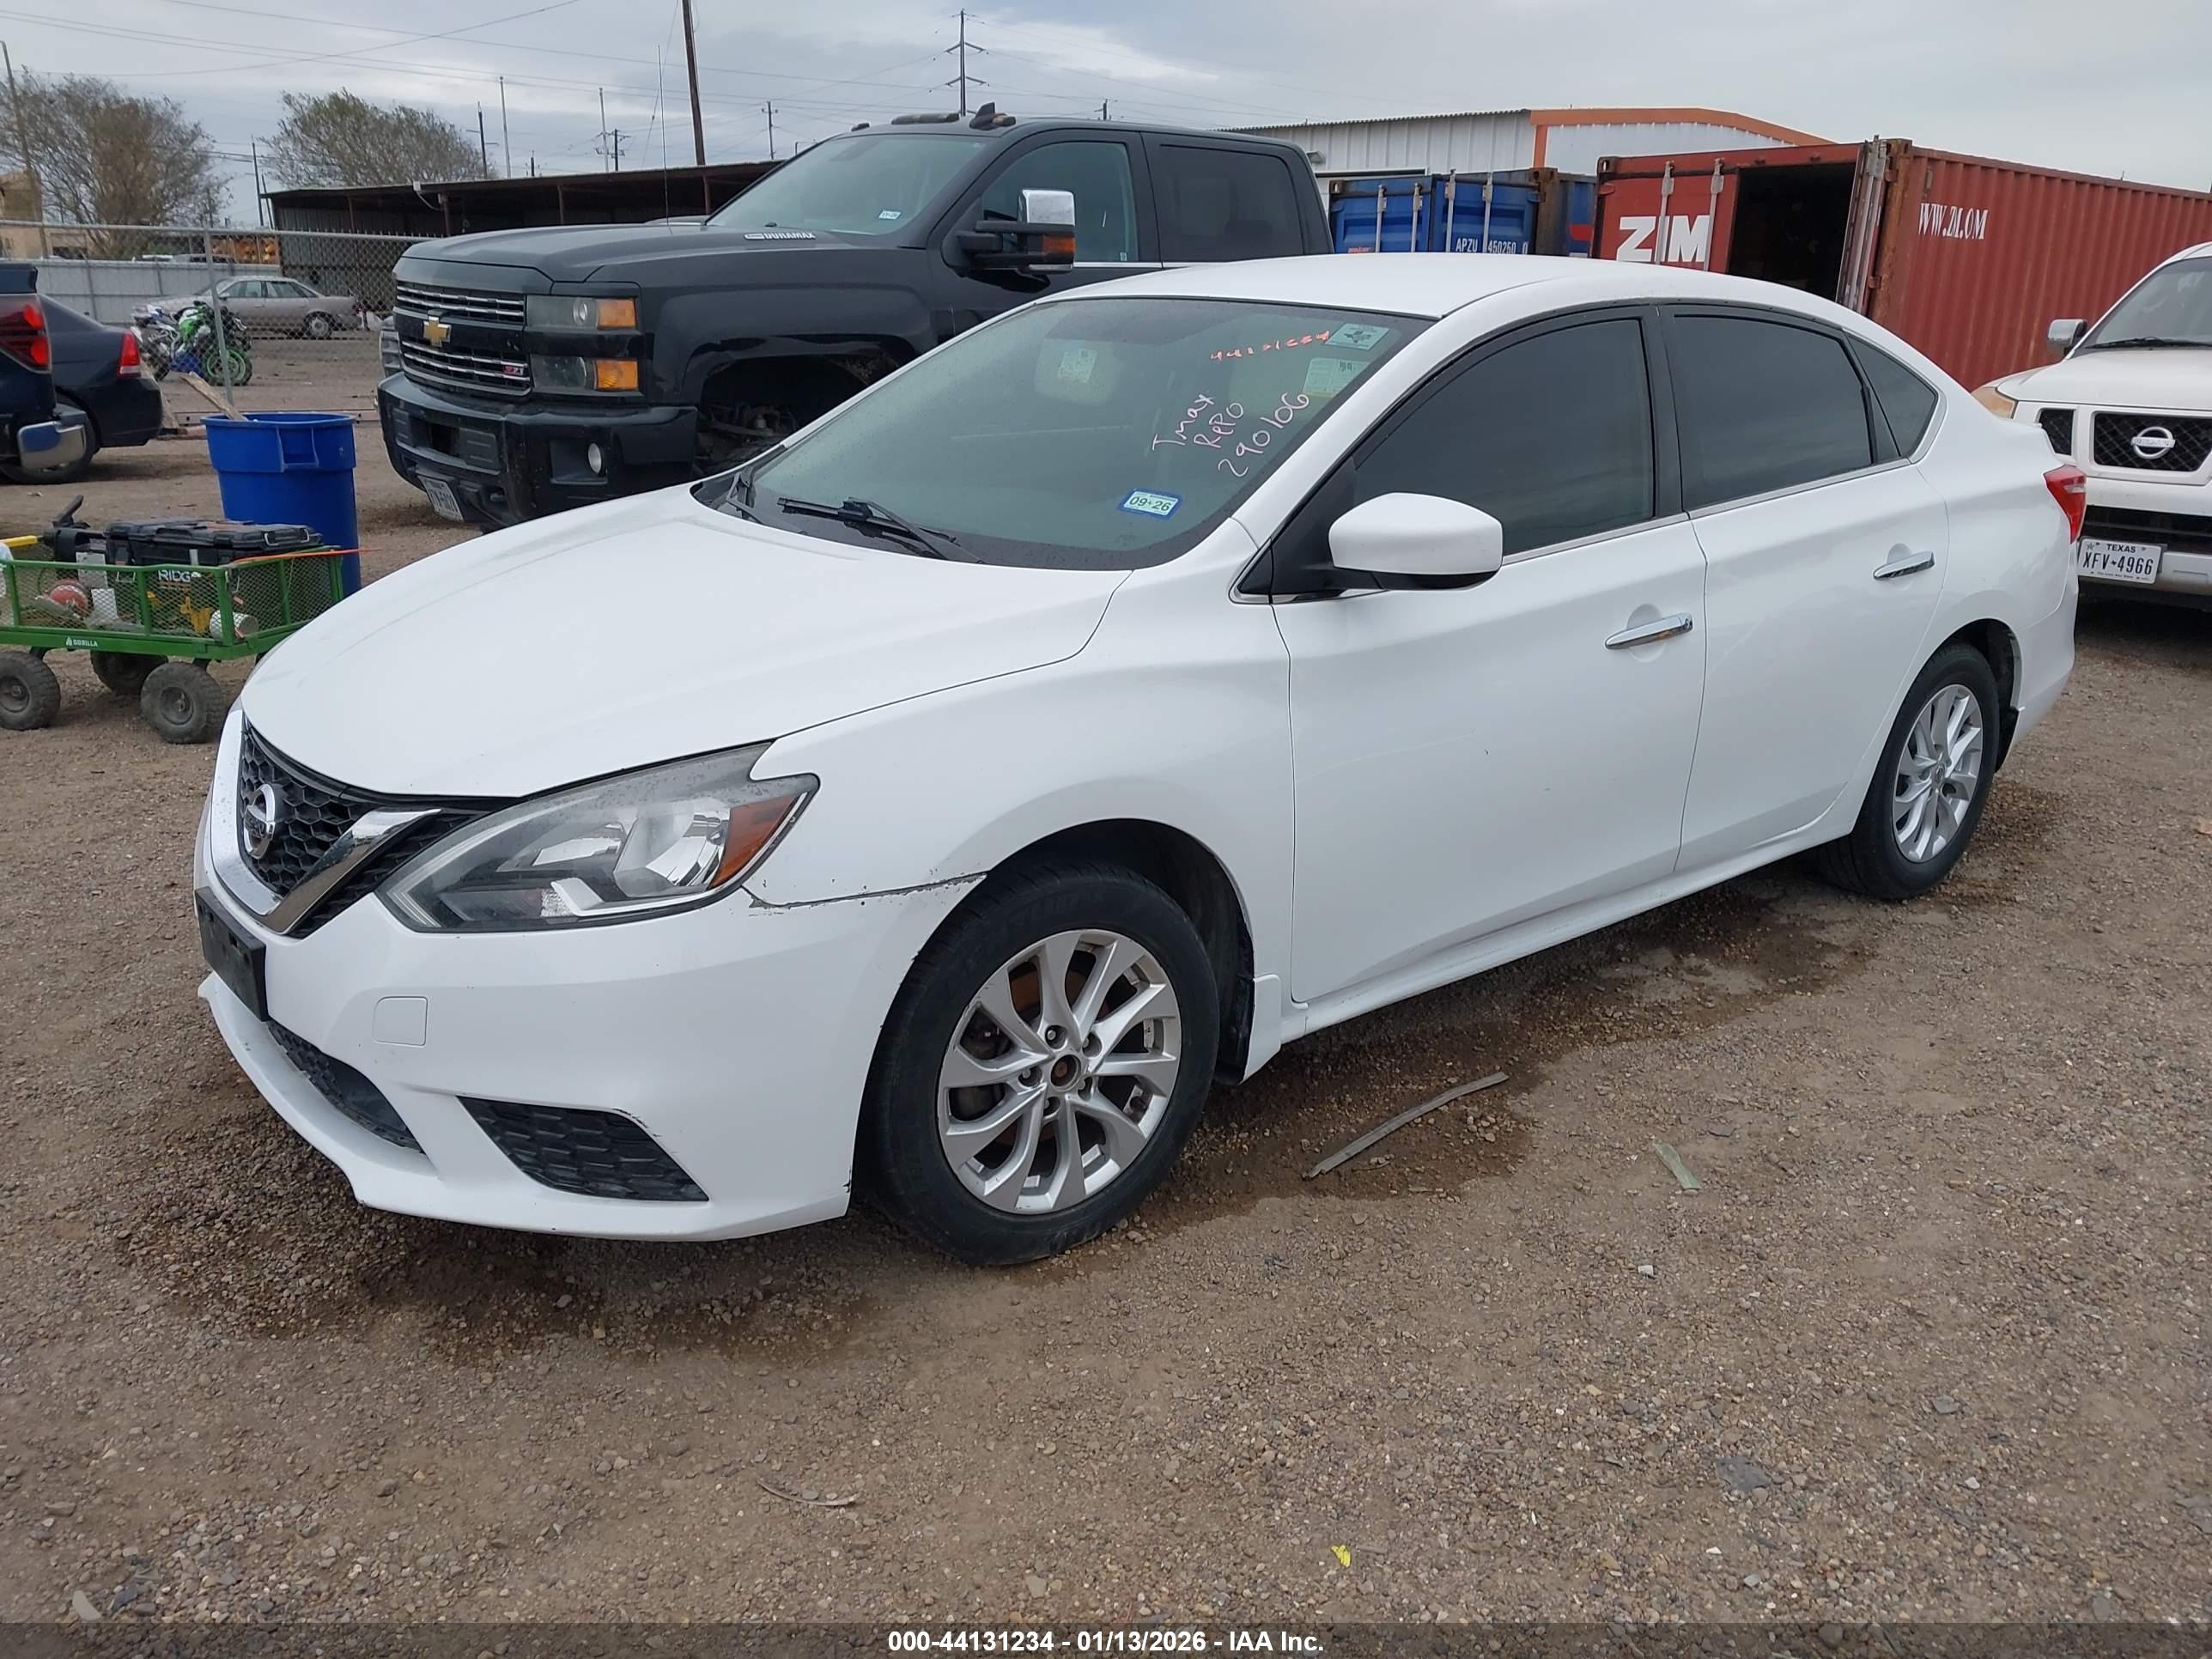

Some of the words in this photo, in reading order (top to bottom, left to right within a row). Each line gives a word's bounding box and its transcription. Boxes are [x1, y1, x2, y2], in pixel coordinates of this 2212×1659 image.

[1455, 238, 1478, 252] APZU
[1487, 240, 1516, 255] 450250
[1616, 215, 1711, 262] ZIM
[1218, 392, 1310, 477] 290106
[1129, 496, 1148, 507] 09
[1152, 501, 1171, 511] 26
[2106, 543, 2136, 554] TEXAS
